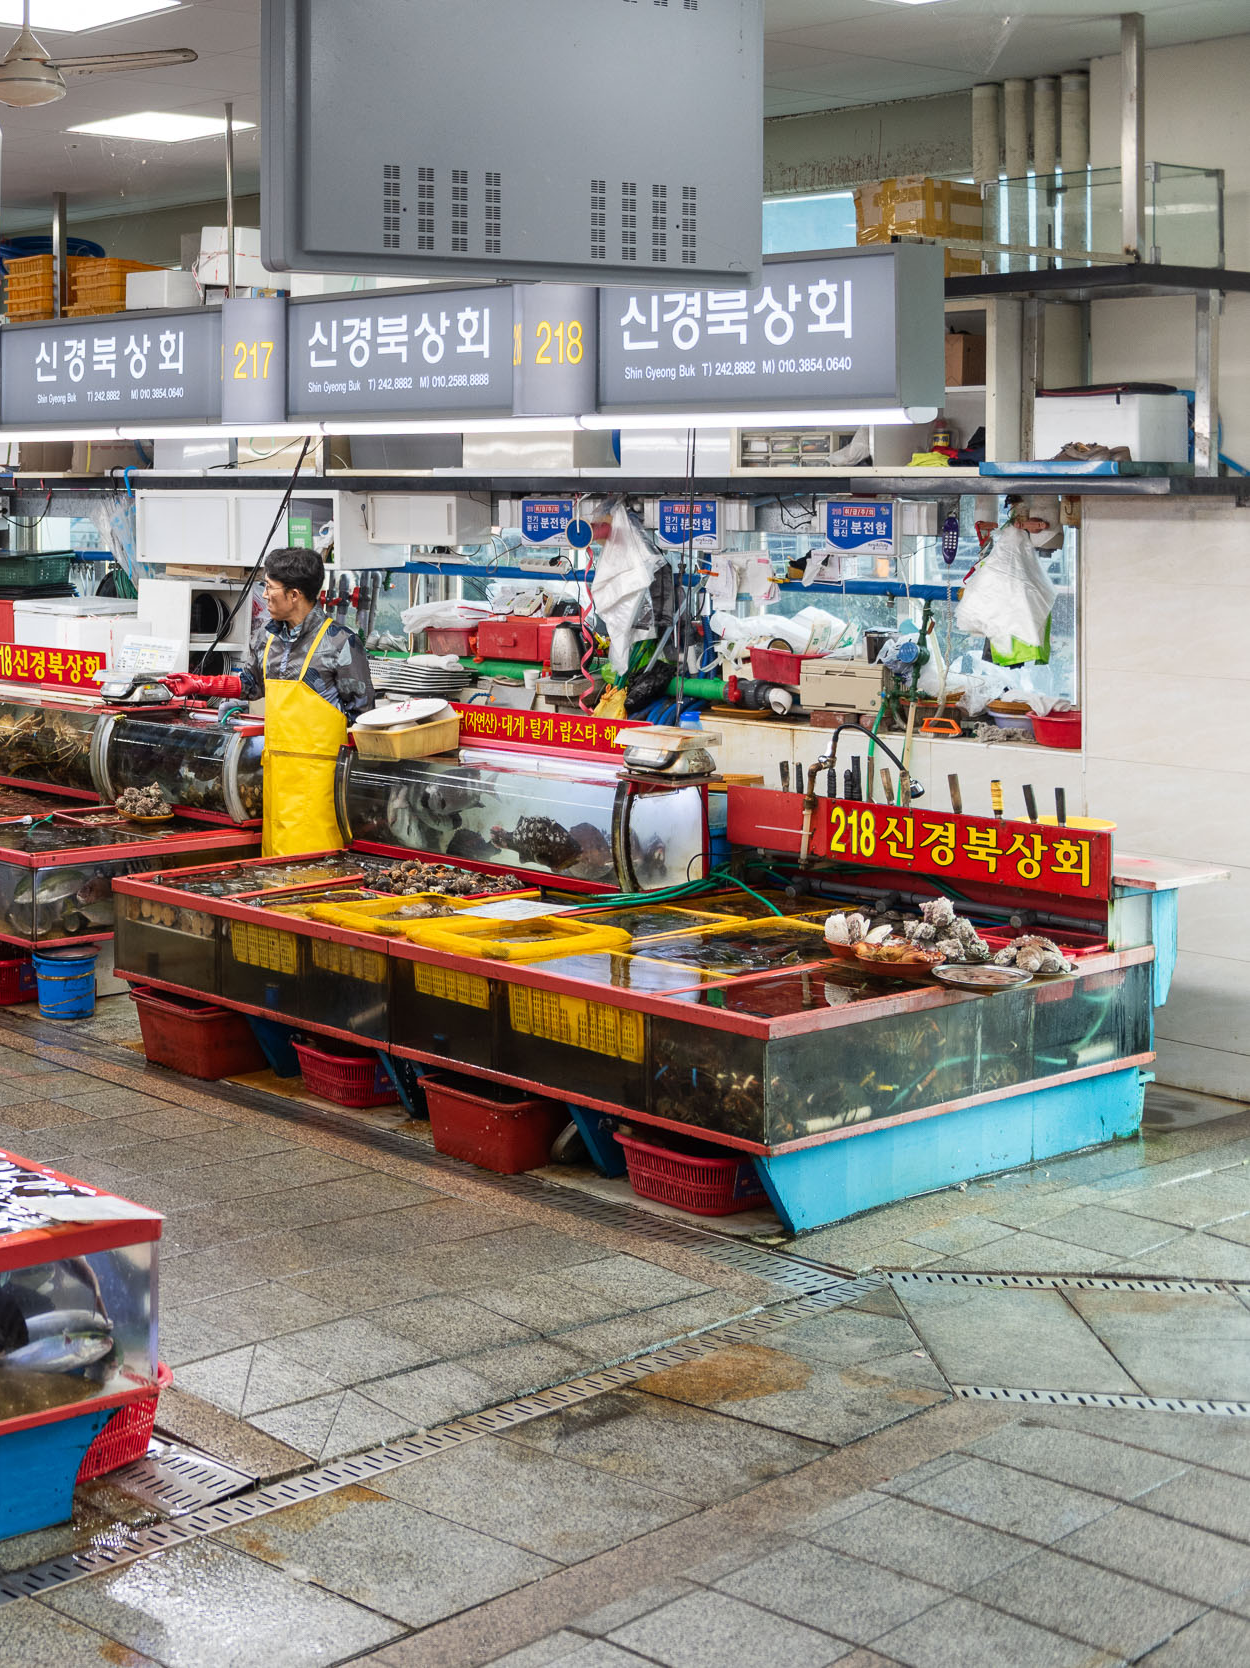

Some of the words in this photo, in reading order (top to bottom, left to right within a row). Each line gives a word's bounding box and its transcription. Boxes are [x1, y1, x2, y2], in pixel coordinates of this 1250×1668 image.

[620, 279, 852, 350] 신경북상회
[308, 307, 490, 368] 신경북상회
[535, 320, 584, 365] 218
[35, 330, 184, 383] 신경북상회
[233, 341, 274, 380] 217
[624, 366, 642, 380] Shin
[645, 366, 676, 381] Gyeong
[679, 364, 696, 378] Buk
[702, 362, 712, 377] T)
[715, 361, 756, 377] 242.8882
[762, 359, 775, 375] M)
[778, 356, 852, 374] 010.3854.0640
[308, 381, 322, 393] Shin
[324, 381, 347, 394] Gyeong
[349, 379, 361, 392] Buk
[368, 379, 376, 391] T)
[378, 377, 413, 391] 242.8882
[419, 376, 430, 389] M)
[432, 374, 489, 388] 010.2588.8888
[37, 393, 48, 404] Shin
[49, 393, 66, 405] Gyeong
[67, 392, 77, 403] Buk
[540, 517, 569, 530] 분전함
[680, 517, 712, 531] 분전함
[850, 520, 887, 536] 분전함
